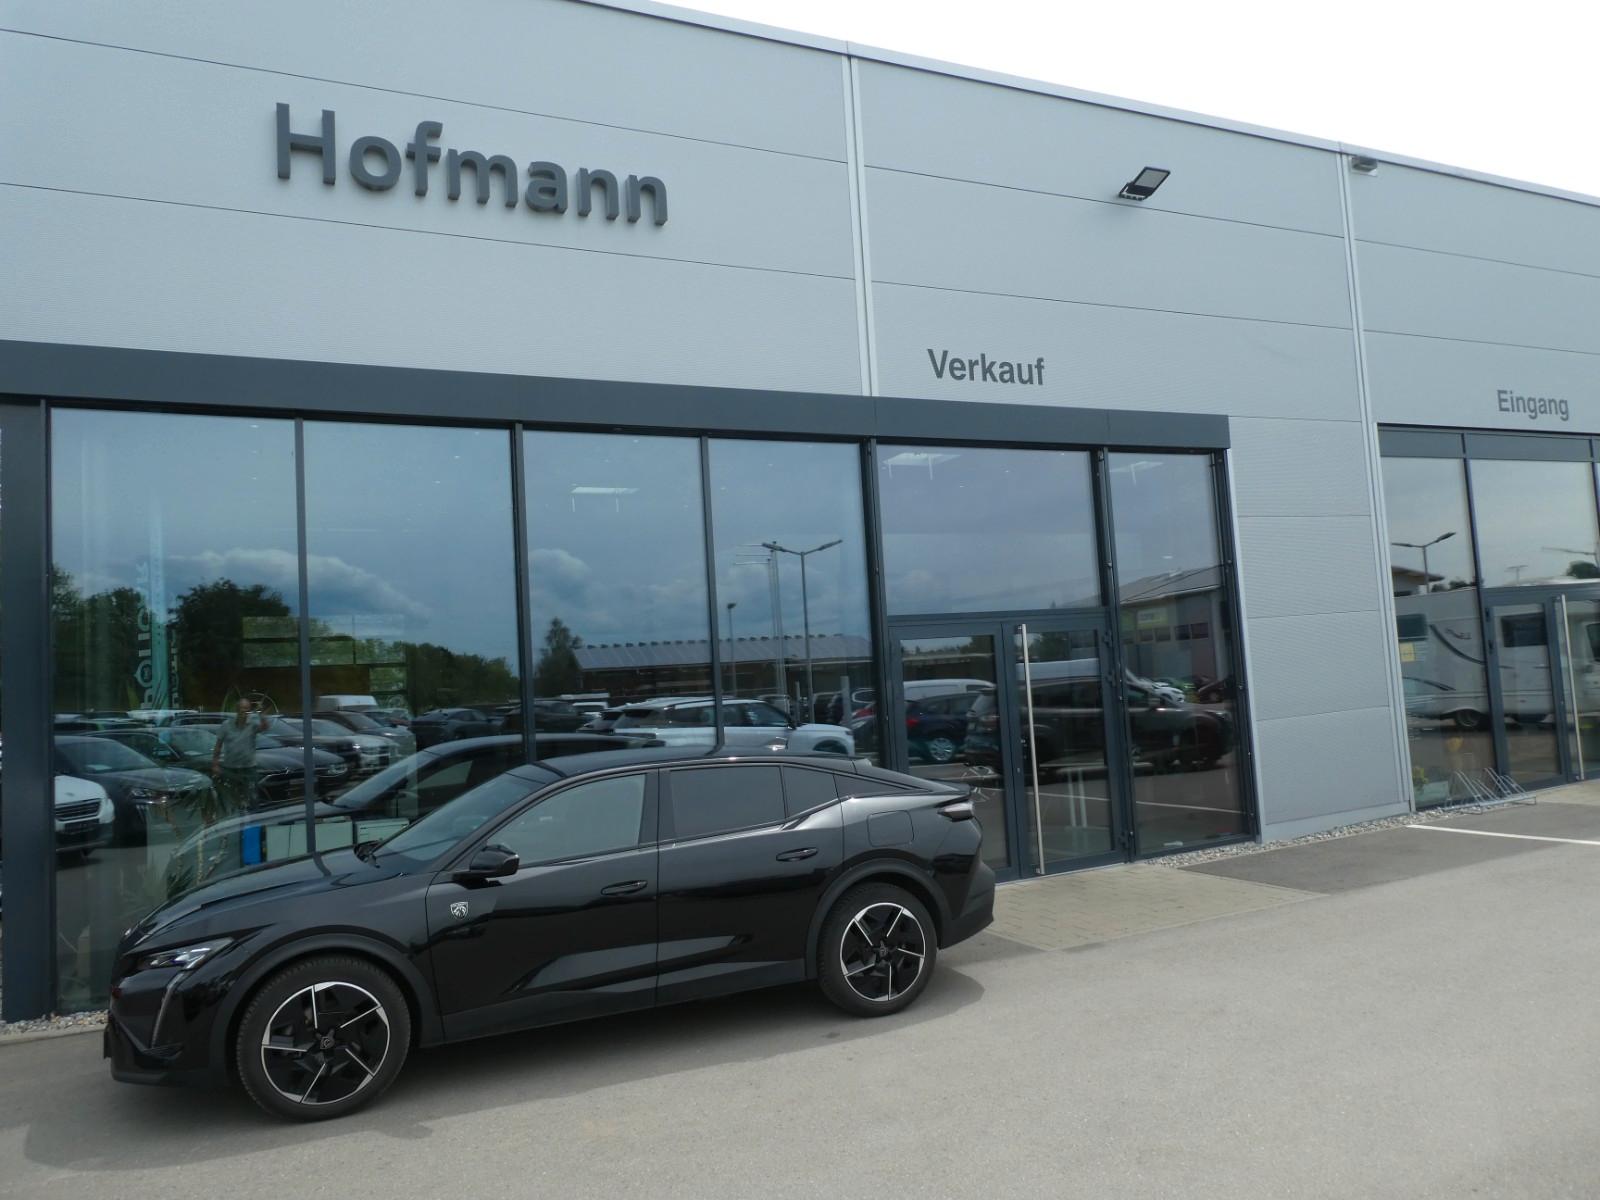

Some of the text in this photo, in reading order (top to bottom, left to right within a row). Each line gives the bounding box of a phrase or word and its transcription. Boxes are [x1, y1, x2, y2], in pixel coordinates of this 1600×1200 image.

[276, 102, 668, 226] Hofmann
[927, 348, 1045, 385] Verkauf
[1497, 389, 1569, 421] Eingang
